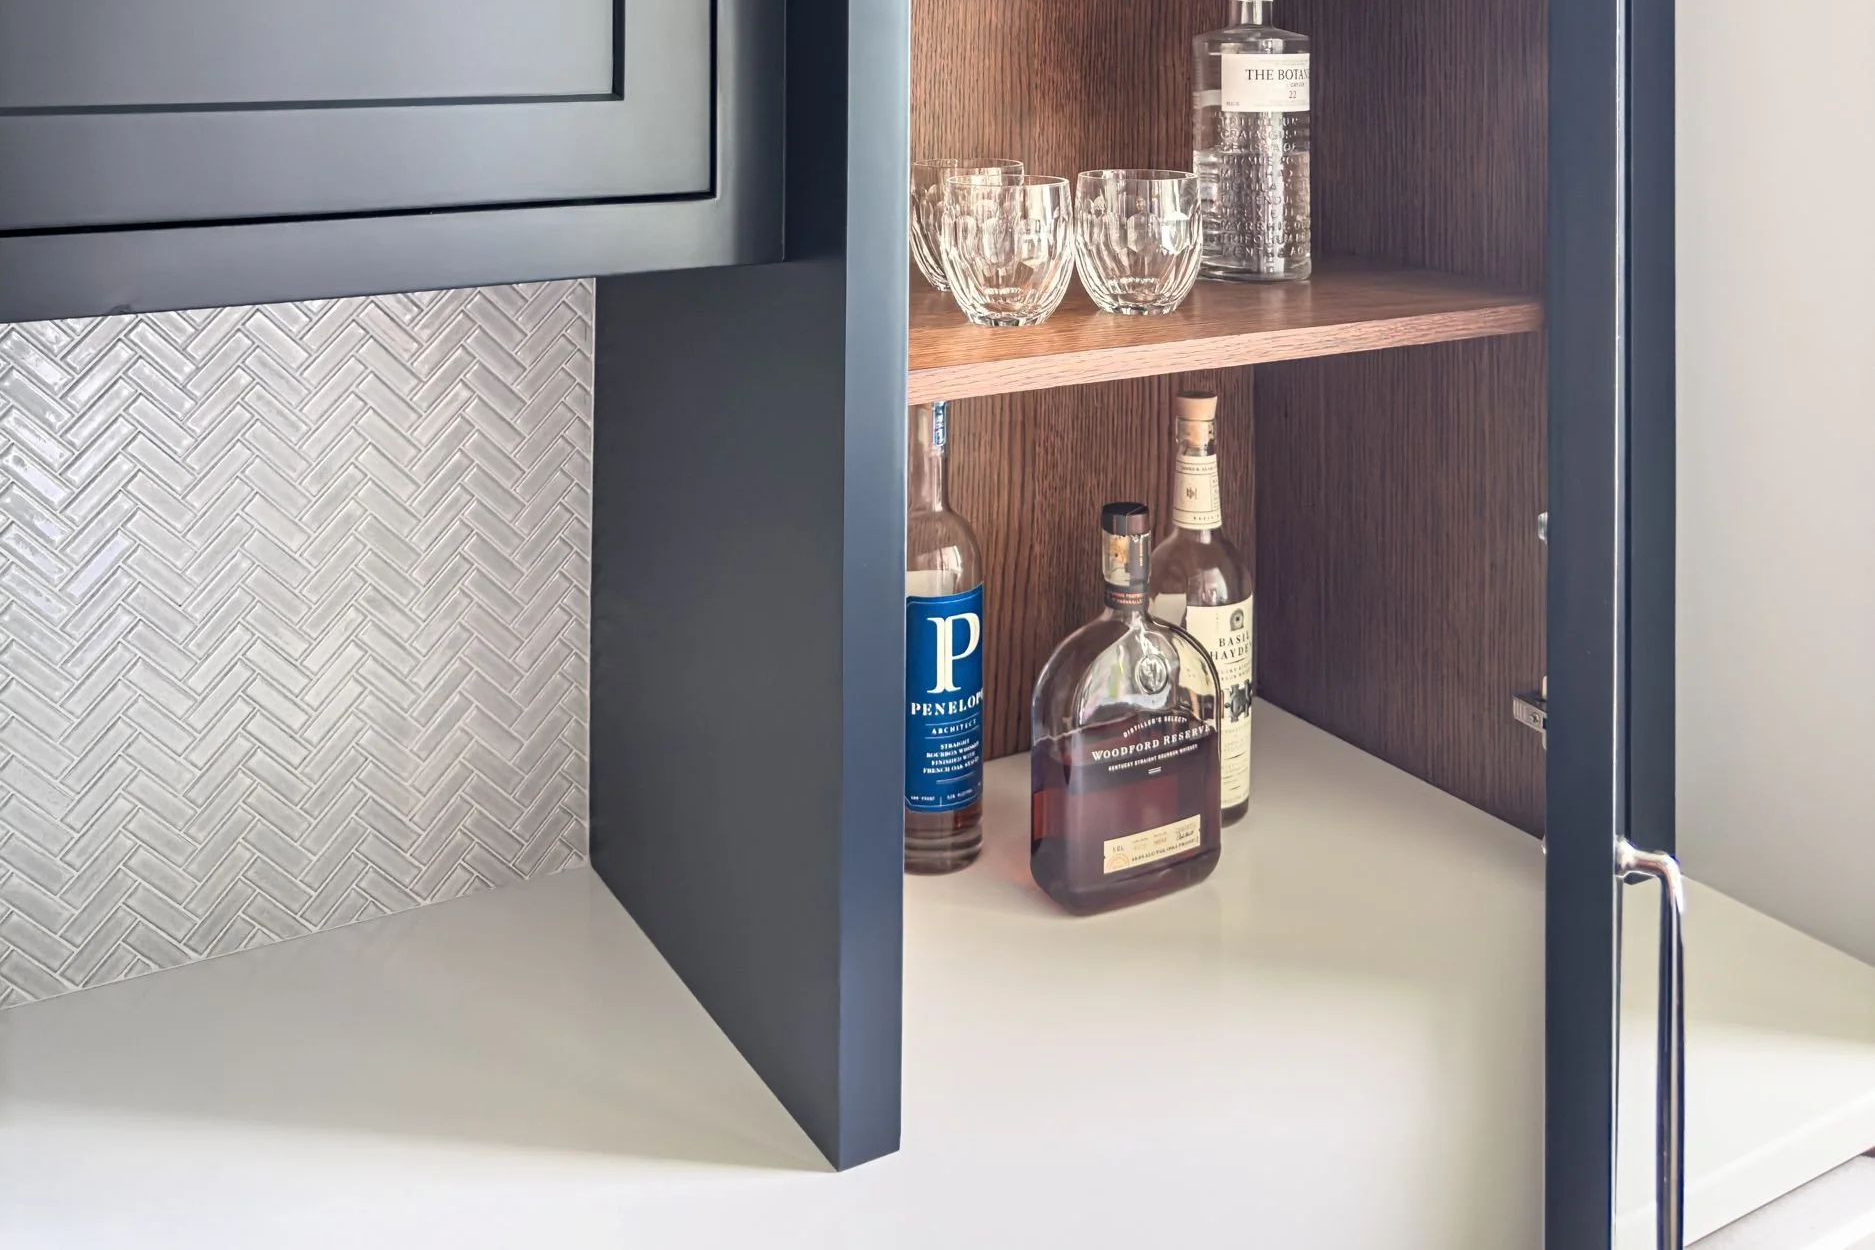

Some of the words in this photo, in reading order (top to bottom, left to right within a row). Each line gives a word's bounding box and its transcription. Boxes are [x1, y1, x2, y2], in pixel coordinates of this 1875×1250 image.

[1245, 69, 1274, 81] THE
[1288, 90, 1297, 99] 22
[1218, 630, 1251, 648] BASIL
[926, 611, 982, 694] P
[931, 718, 977, 736] ARCHITECT
[940, 737, 970, 751] STRAIGHT
[1091, 738, 1160, 762] WOODFORD
[1163, 723, 1211, 746] RESERVE
[922, 766, 951, 775] FRENCH
[951, 762, 964, 772] OAK
[930, 755, 962, 767] FINISHED
[1107, 761, 1134, 772] KENTUCKY
[1134, 755, 1157, 767] STRAIGHT
